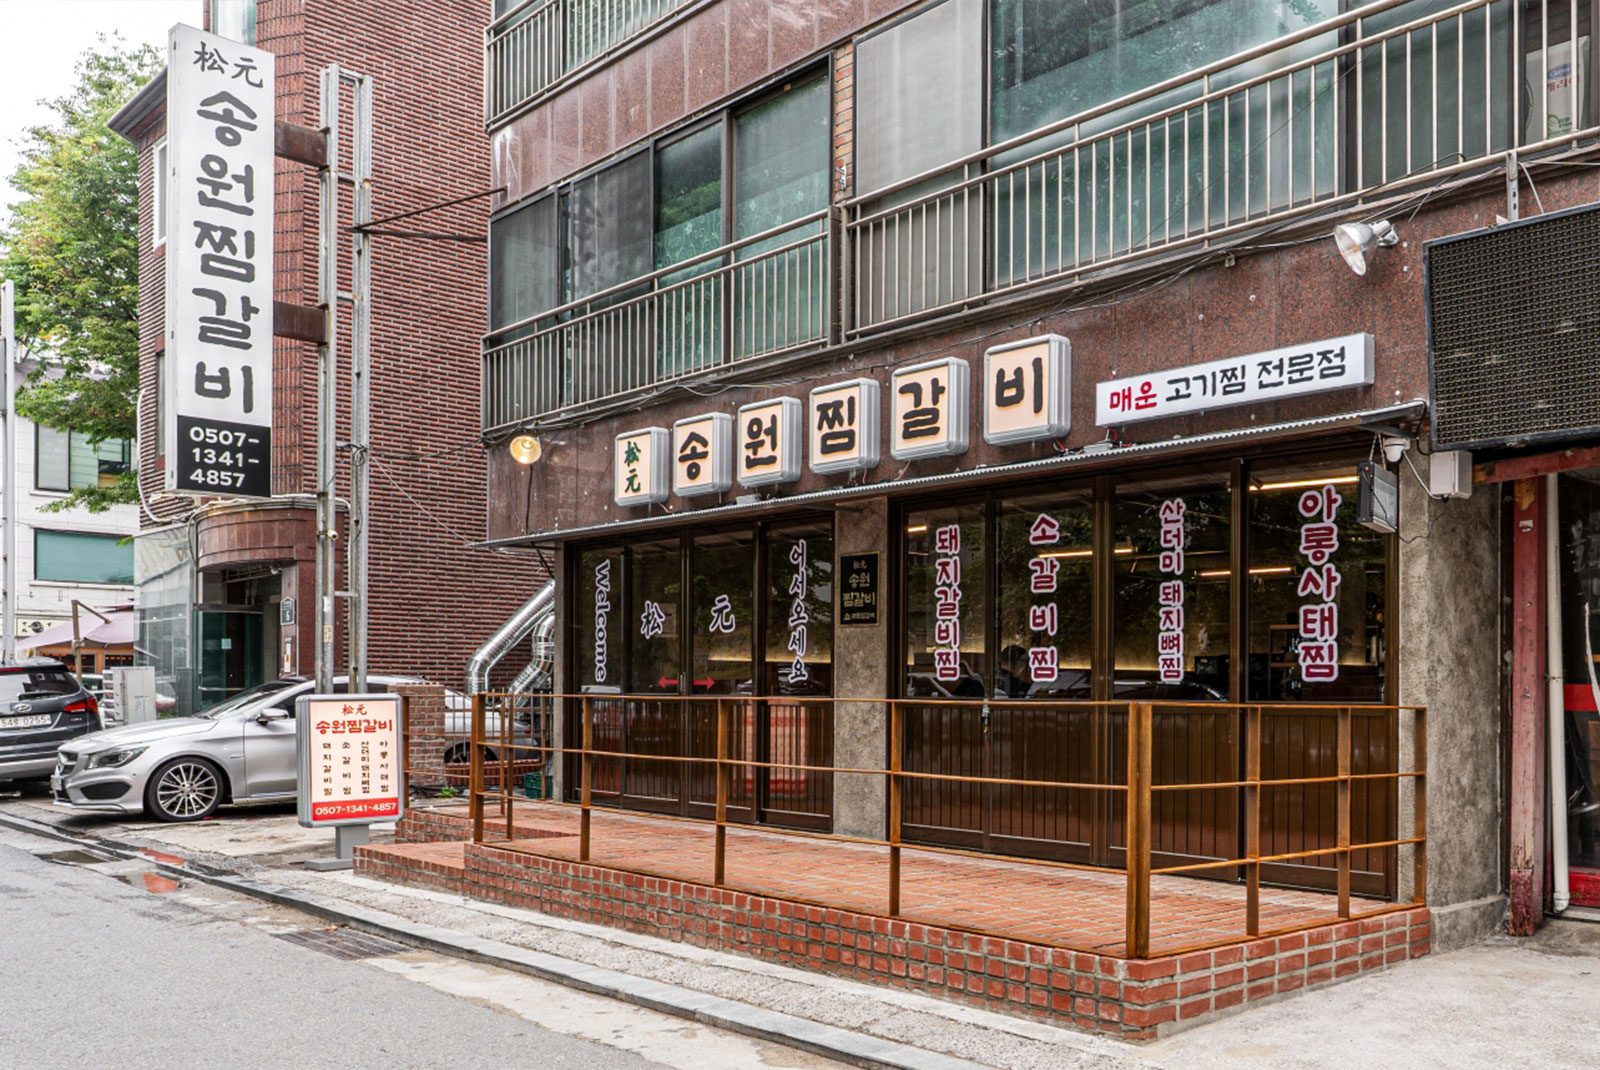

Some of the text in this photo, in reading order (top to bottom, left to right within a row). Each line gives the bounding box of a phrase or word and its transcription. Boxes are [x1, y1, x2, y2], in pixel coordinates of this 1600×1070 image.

[193, 41, 264, 88] 松元
[192, 91, 260, 413] 송원찜갈비
[1109, 346, 1346, 412] 매운 고기찜 전문점
[190, 426, 260, 447] 0507-
[678, 356, 1044, 481] 송원찜갈비
[190, 468, 246, 488] 4857
[192, 447, 260, 468] 1341-
[624, 440, 642, 493] 松元
[788, 539, 808, 684] 어서오세요
[935, 524, 962, 682] 돼지갈비찜
[1029, 513, 1060, 683] 소갈비찜
[1158, 498, 1186, 683] 산더미 돼지뼈찜
[1298, 484, 1342, 683] 아롱사태찜
[595, 559, 611, 683] Welcome
[315, 719, 393, 735] 송원찜갈비
[342, 704, 368, 716] 松元
[315, 802, 397, 816] 0507-1341-4857
